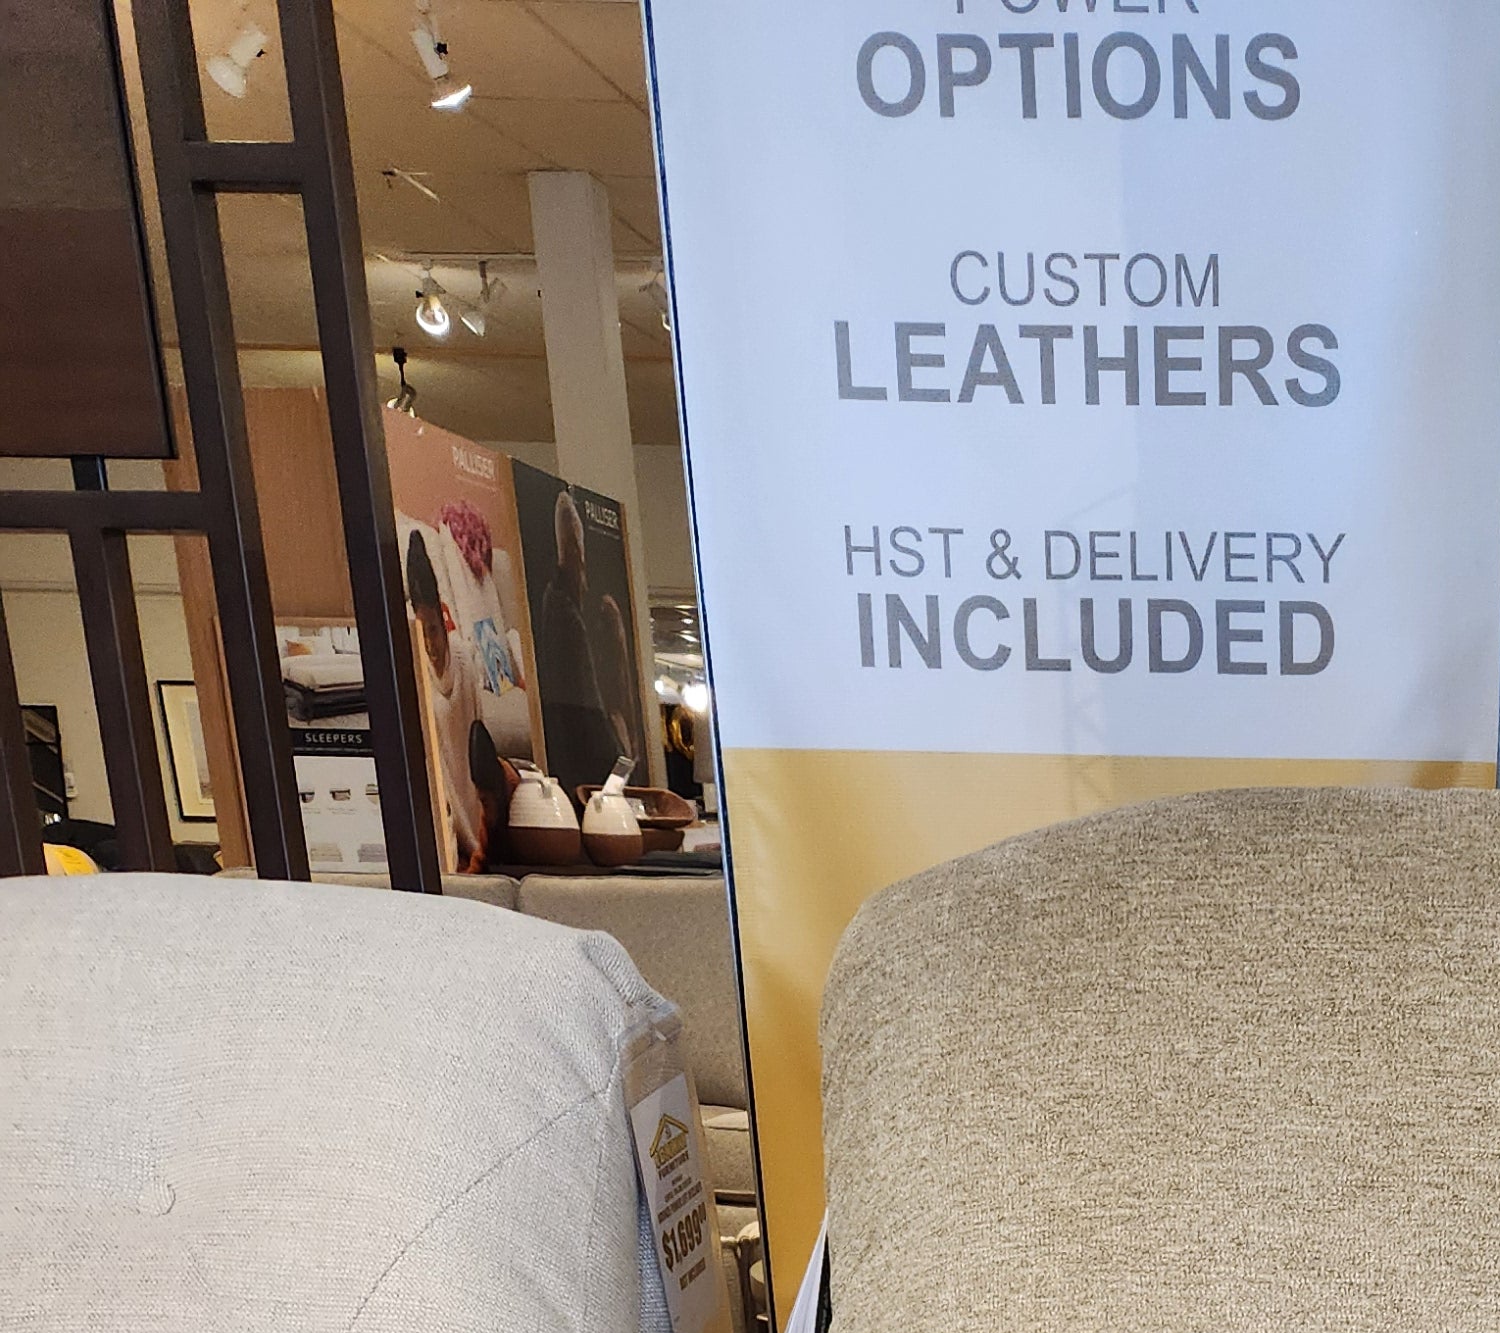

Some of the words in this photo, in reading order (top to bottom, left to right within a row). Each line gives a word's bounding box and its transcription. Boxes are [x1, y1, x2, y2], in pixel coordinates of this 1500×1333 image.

[856, 32, 1300, 121] OPTIONS
[949, 250, 1220, 307] CUSTOM
[833, 320, 1341, 407] LEATHERS
[452, 446, 495, 480] PALLISER
[584, 500, 620, 530] PALLISER
[843, 525, 965, 579] HST
[985, 528, 1023, 581] &
[1044, 530, 1347, 584] DELIVERY
[857, 592, 1336, 677] INCLUDED
[304, 732, 363, 744] SLEEPERS
